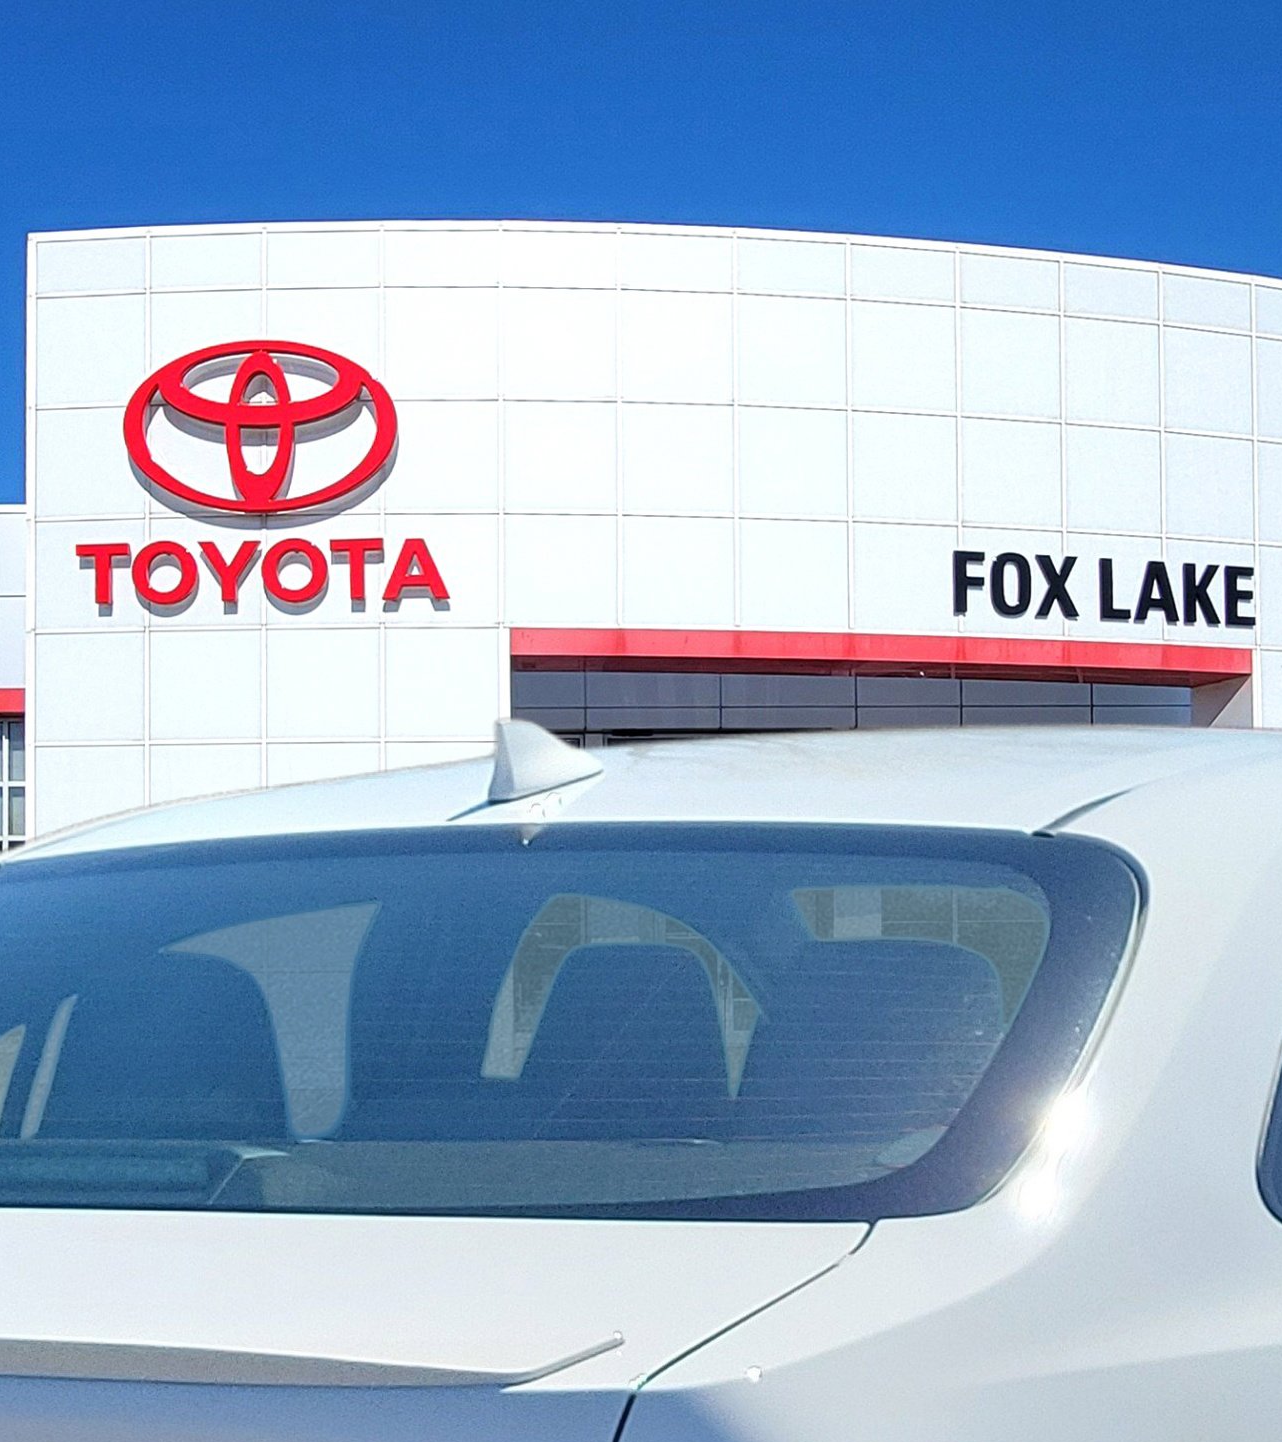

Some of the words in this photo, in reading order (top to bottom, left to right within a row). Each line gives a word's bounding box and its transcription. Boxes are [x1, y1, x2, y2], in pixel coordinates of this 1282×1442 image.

[75, 537, 451, 606] TOYOTA
[953, 550, 1079, 620] FOX
[1099, 557, 1256, 627] LAKE
